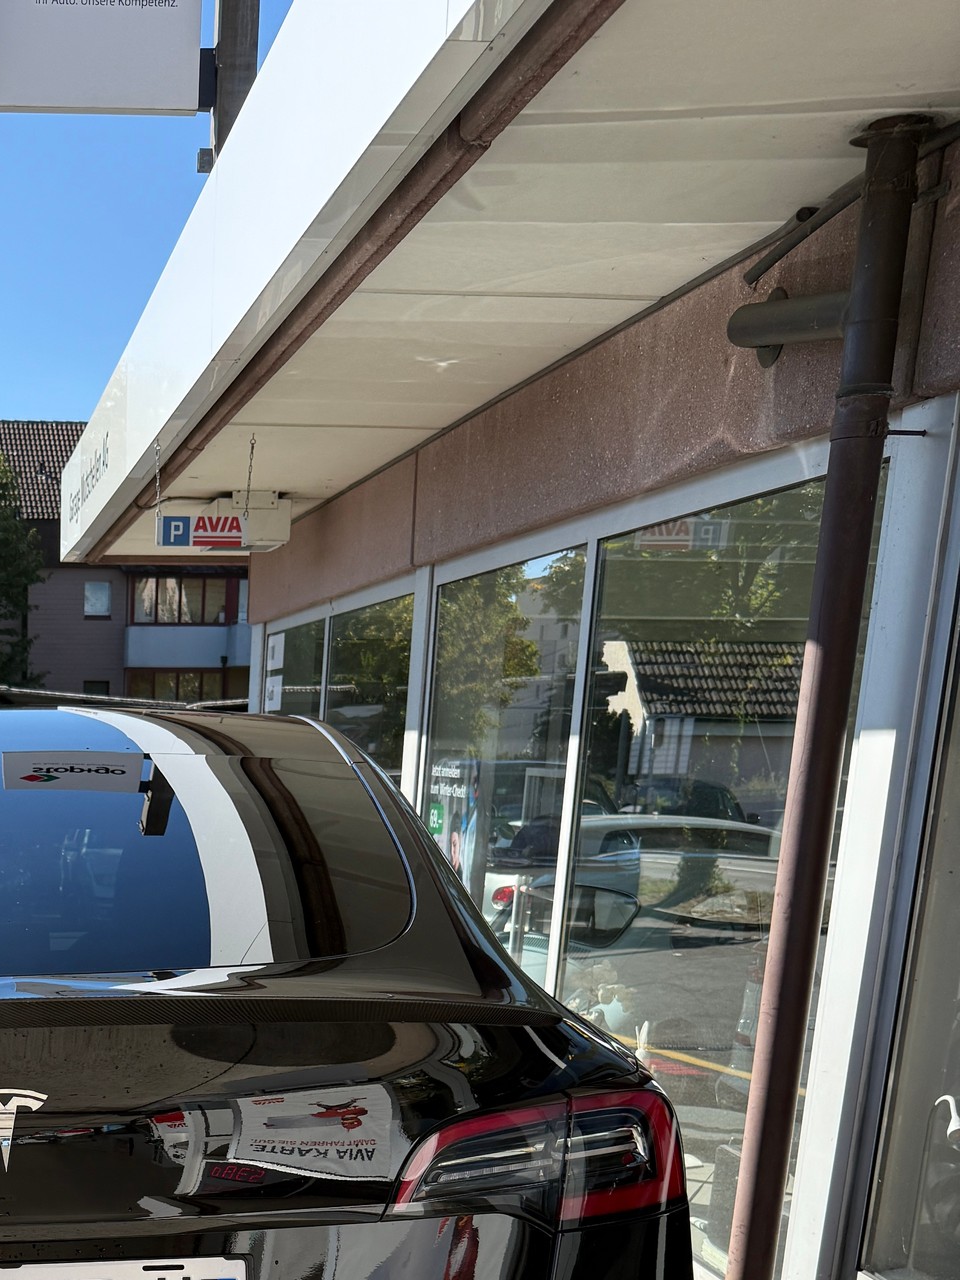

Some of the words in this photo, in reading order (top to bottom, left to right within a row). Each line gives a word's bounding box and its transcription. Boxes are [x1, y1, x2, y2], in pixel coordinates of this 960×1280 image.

[118, 0, 178, 8] Kompetenz.
[170, 521, 184, 543] P
[193, 516, 243, 533] AVIA
[300, 1139, 345, 1147] FAHREN
[346, 1138, 377, 1147] DAMIT
[250, 1143, 330, 1159] KARTE.
[335, 1147, 376, 1162] AVIA
